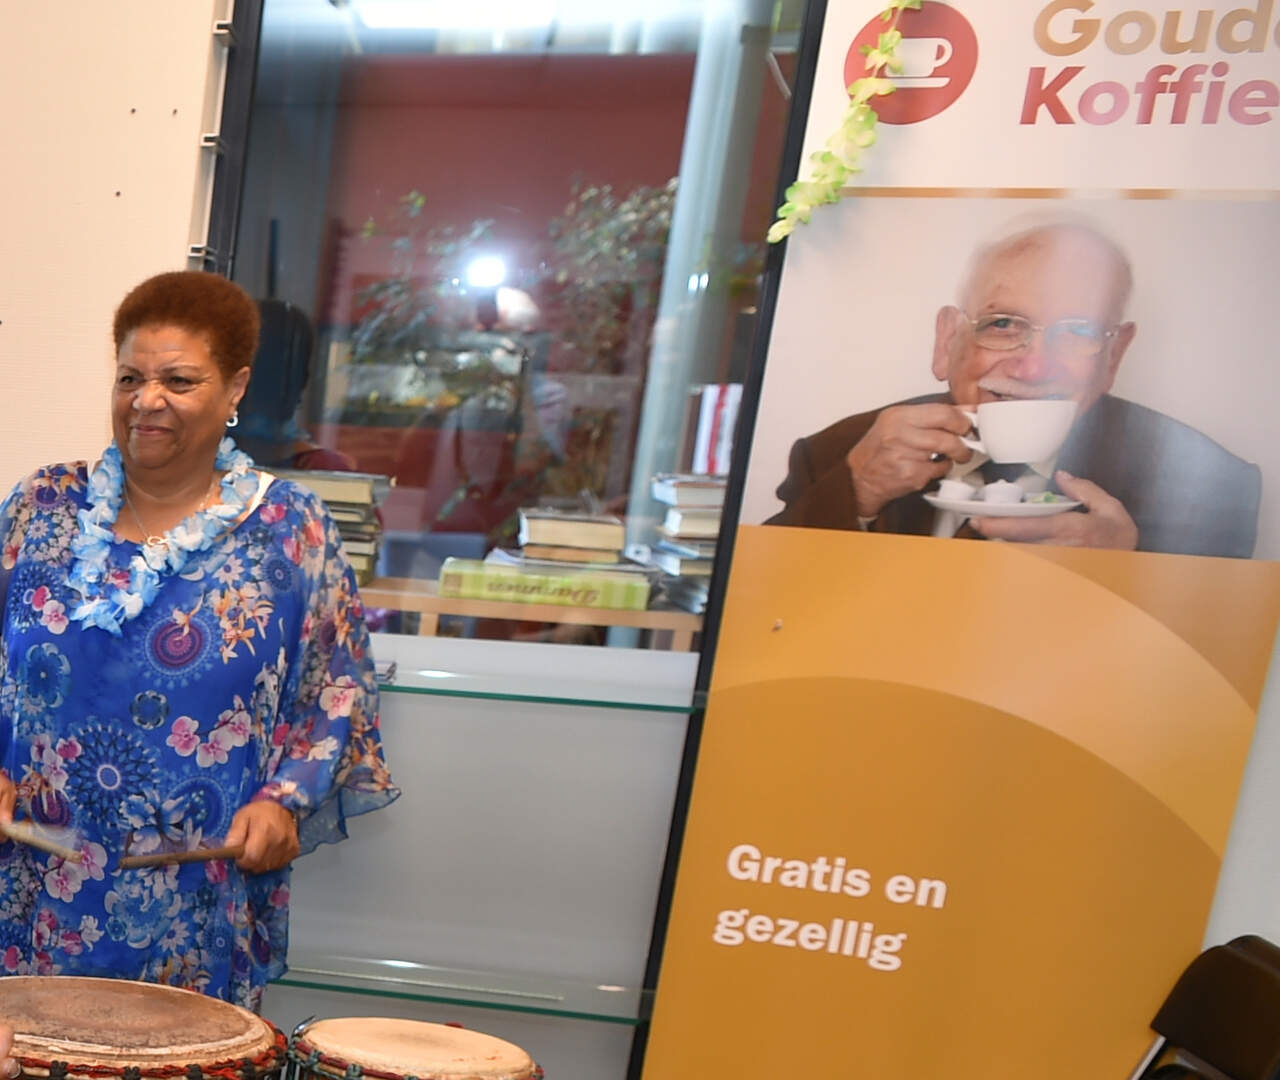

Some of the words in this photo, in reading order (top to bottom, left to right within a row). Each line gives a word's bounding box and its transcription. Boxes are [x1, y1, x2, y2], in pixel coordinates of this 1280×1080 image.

[1033, 0, 1280, 57] Goud
[1019, 61, 1280, 126] Koffie
[726, 844, 871, 897] Gratis
[885, 874, 948, 908] en
[713, 908, 908, 971] gezellig
